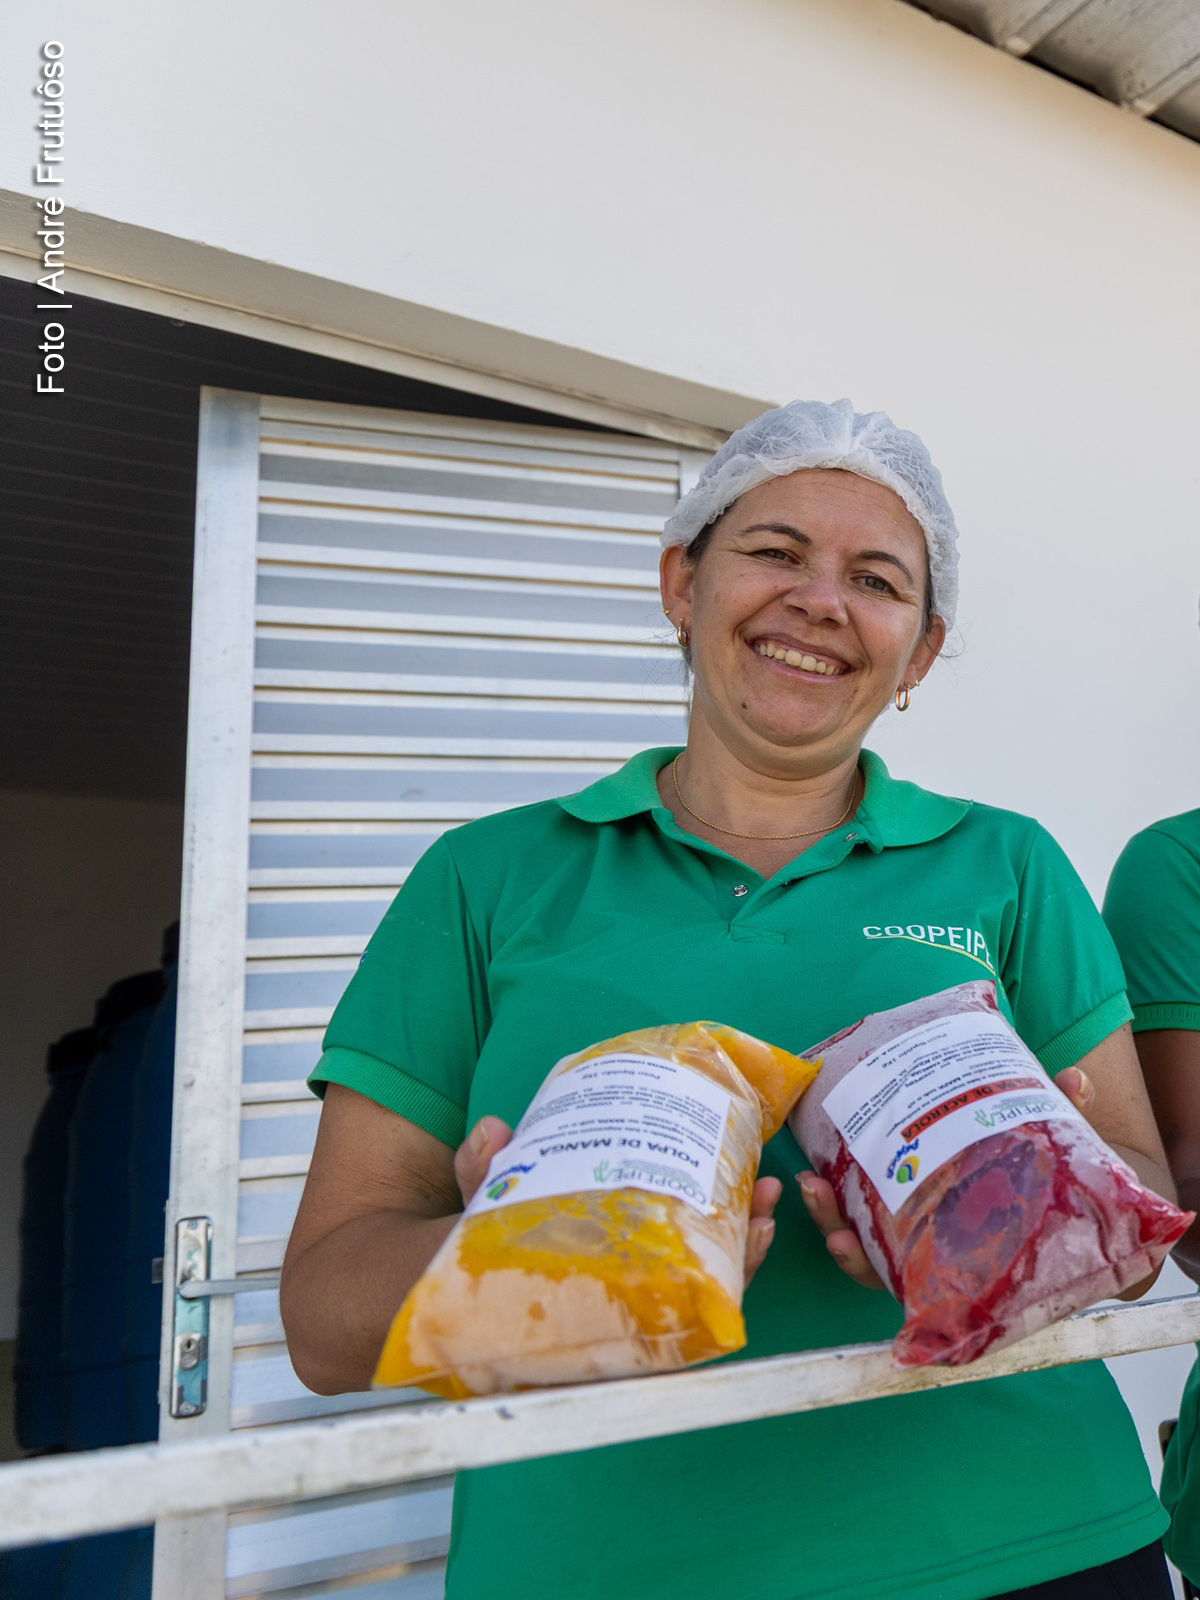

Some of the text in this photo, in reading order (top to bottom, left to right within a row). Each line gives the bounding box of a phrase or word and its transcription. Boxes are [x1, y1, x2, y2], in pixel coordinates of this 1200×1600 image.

[972, 1084, 992, 1099] DE
[901, 1094, 968, 1138] ACEROLA
[539, 1137, 699, 1168] POLPA DE MANGA
[612, 1168, 704, 1205] COOPEIPE
